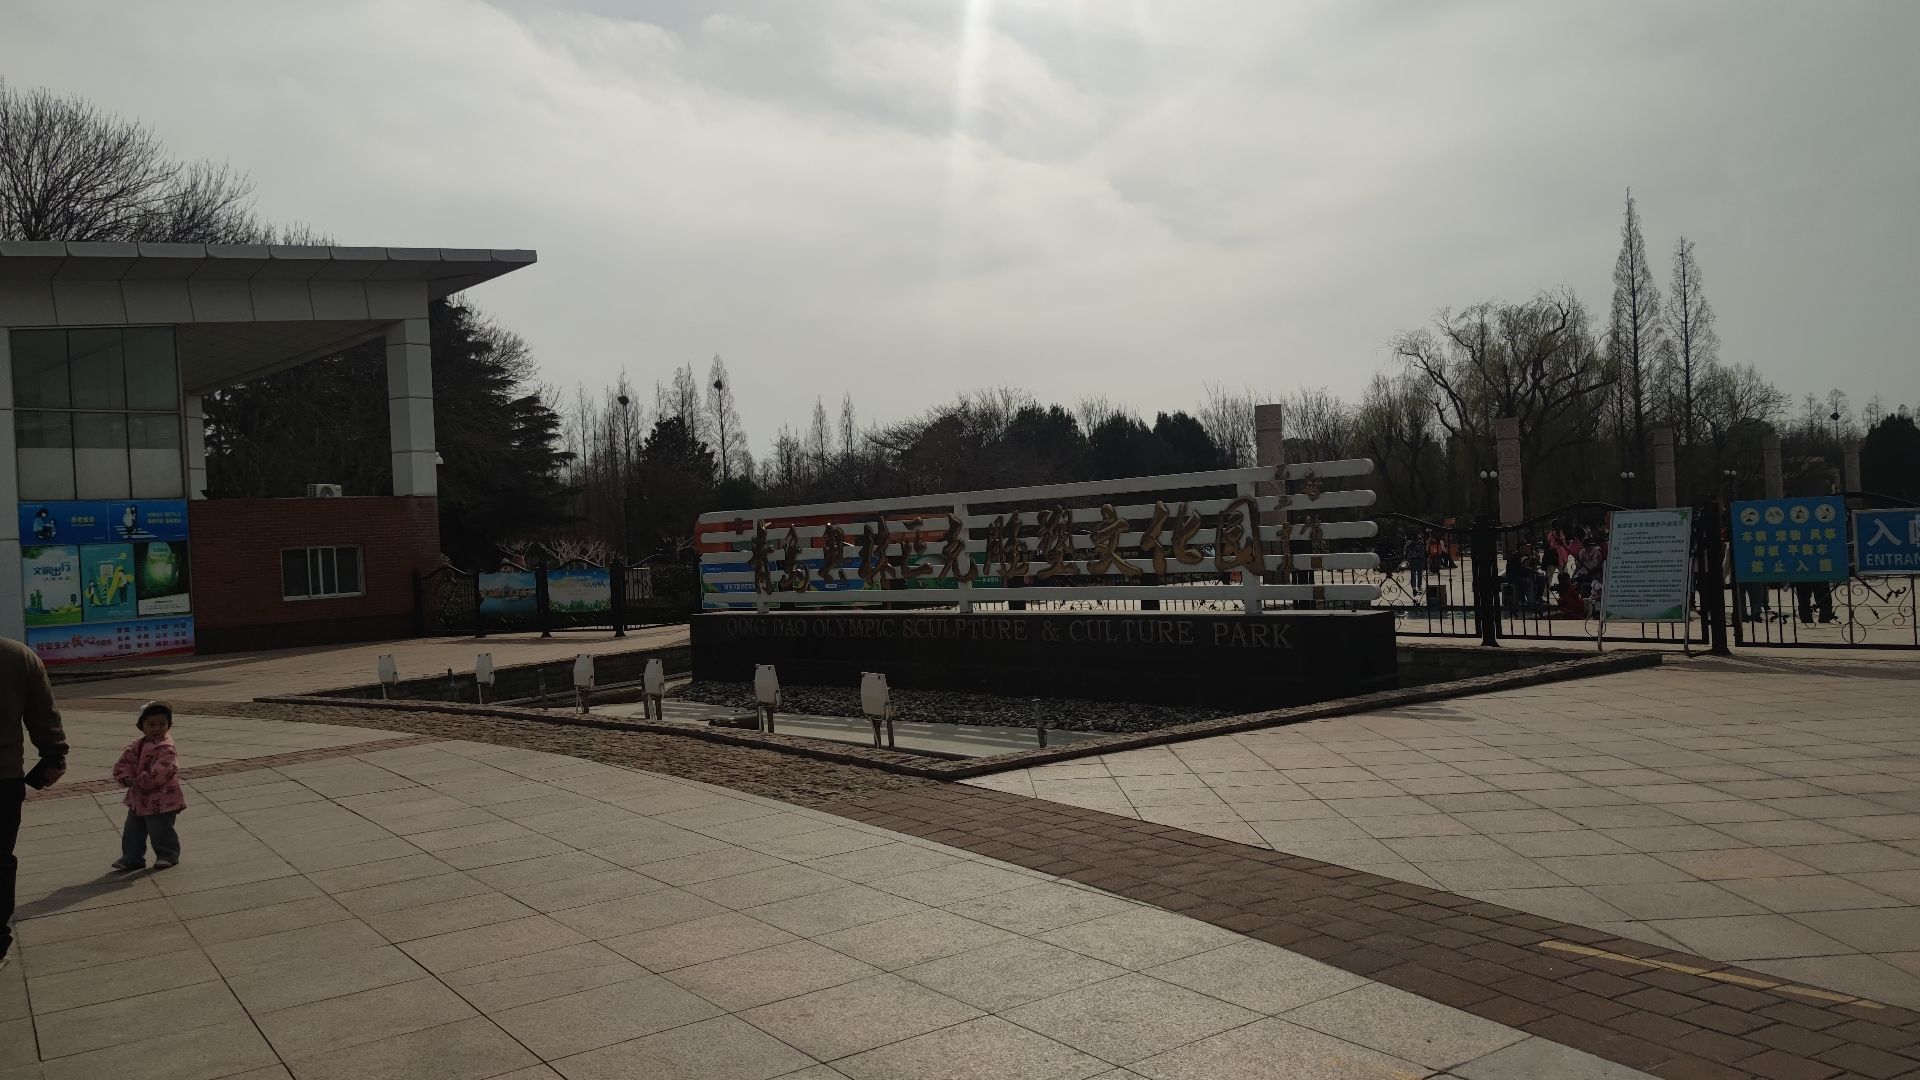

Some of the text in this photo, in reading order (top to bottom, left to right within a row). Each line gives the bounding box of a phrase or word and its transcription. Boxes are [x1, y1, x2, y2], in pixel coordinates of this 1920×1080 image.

[727, 618, 1295, 649] QING DAO OLYMPIC SCULPTURE & CULTURE PARK
